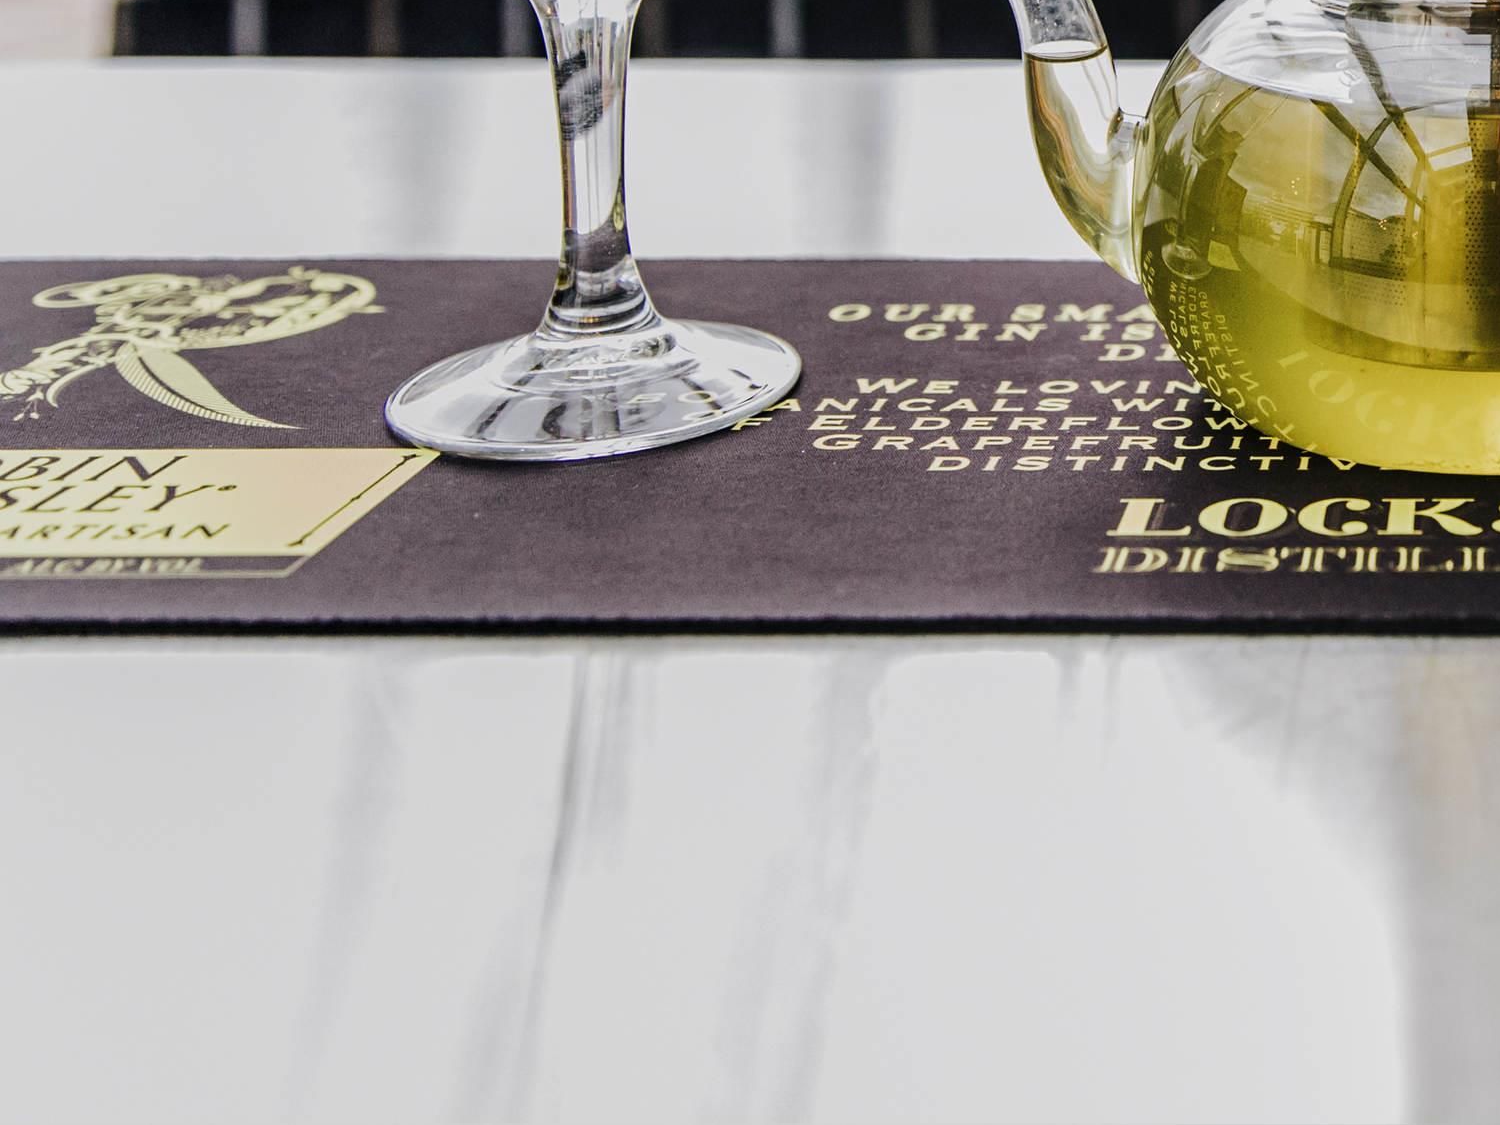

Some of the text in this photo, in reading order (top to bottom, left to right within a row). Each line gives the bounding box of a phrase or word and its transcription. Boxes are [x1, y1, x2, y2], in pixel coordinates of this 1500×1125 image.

[828, 304, 1158, 322] OUR SMA
[903, 323, 1048, 341] GIN
[1080, 323, 1156, 341] IS
[856, 377, 1204, 395] WE LOVIN
[809, 414, 1247, 431] ELDERFLOW
[0, 455, 189, 482] BIN
[927, 455, 1360, 472] DISTINCTIV
